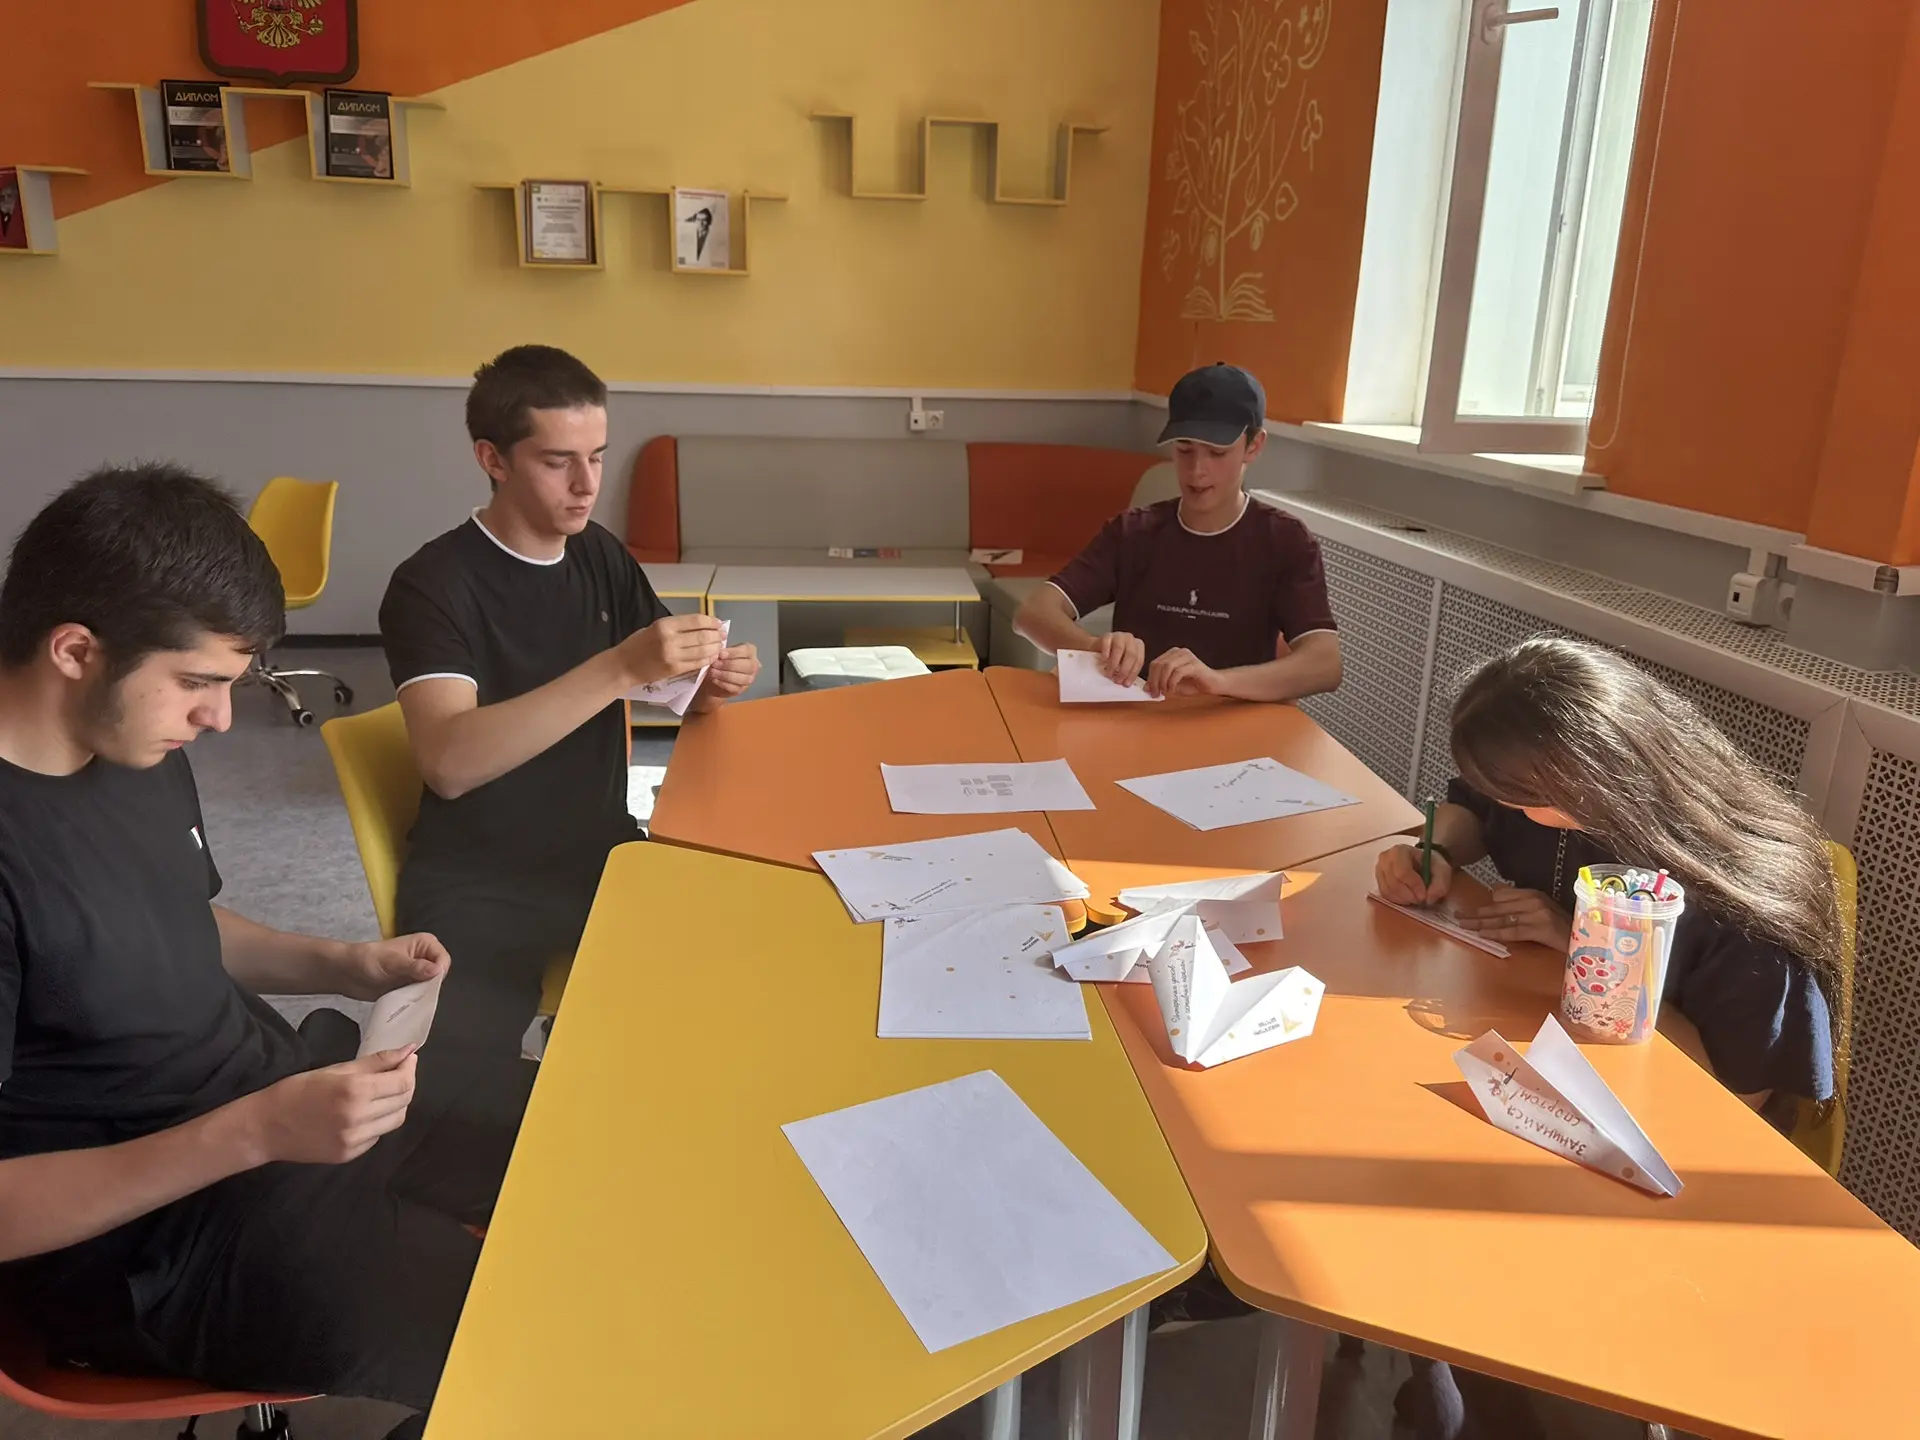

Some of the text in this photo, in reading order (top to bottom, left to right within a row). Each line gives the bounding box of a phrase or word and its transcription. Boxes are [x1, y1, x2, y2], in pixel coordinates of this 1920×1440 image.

[175, 92, 219, 102] ДИПЛОМ
[337, 101, 380, 112] ДИПЛОМ
[1509, 1087, 1581, 1127] СПОРТОМ!
